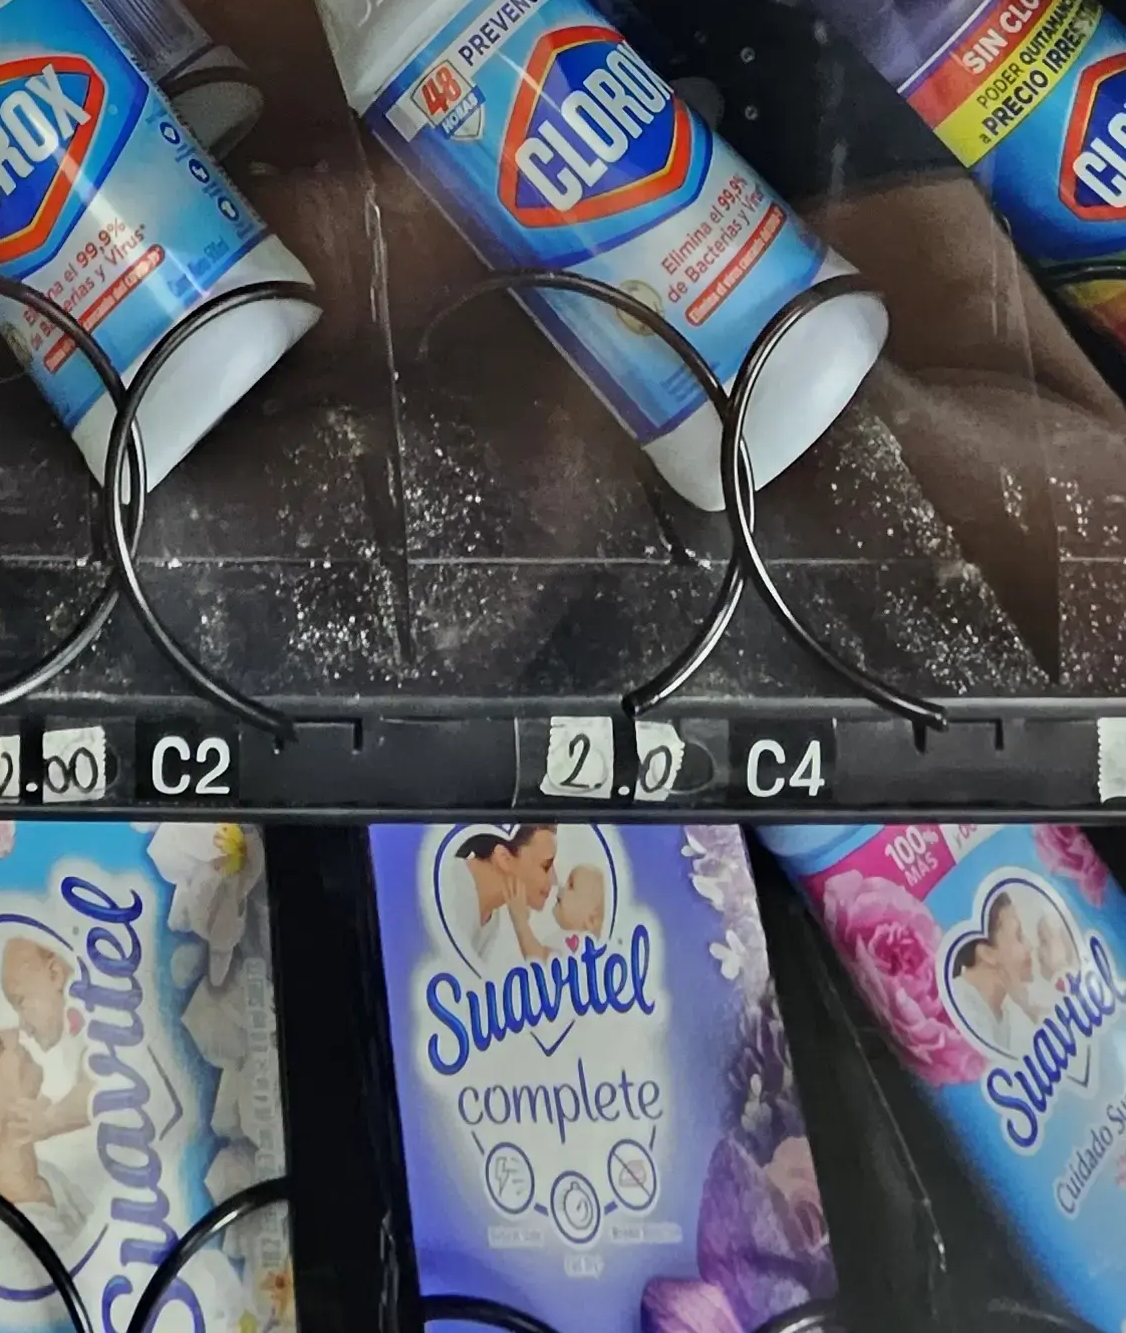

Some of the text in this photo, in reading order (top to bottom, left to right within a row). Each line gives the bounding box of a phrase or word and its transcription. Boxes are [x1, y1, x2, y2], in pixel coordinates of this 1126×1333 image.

[961, 27, 1009, 76] SIN
[976, 61, 1025, 110] PODER
[421, 65, 462, 116] 48
[514, 41, 675, 213] CLOROX
[979, 68, 1050, 145] a PRECIO
[660, 220, 713, 276] Elimina
[709, 204, 724, 224] el
[666, 208, 751, 304] de Bacterias y
[39, 275, 96, 336] Baerias
[151, 735, 232, 796] C2
[745, 739, 825, 799] C4
[425, 923, 656, 1077] Suavitel
[986, 935, 1126, 1149] Suavitel
[59, 874, 208, 1332] Suavitel
[457, 1057, 665, 1145] complete
[1055, 1124, 1114, 1216] Cuidado
